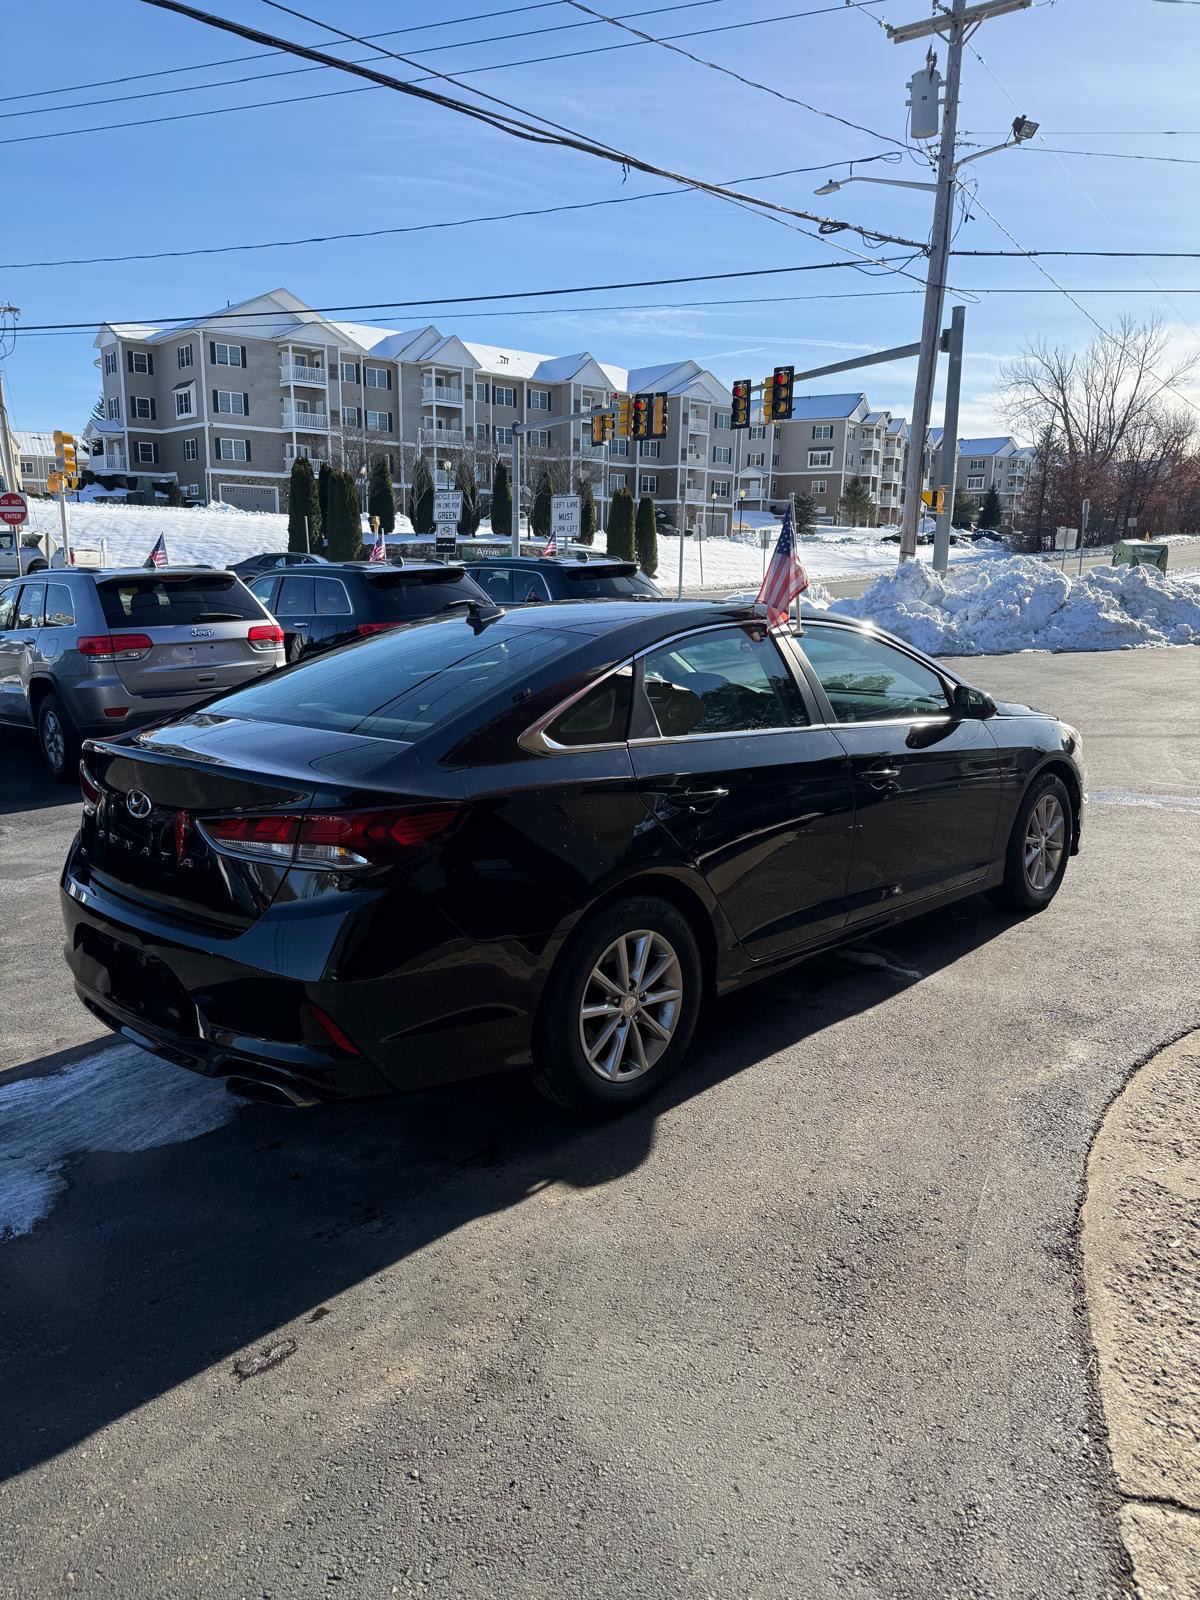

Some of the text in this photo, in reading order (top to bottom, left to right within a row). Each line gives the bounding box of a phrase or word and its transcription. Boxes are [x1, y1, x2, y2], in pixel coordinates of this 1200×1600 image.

[554, 501, 578, 509] LEFT LANE
[437, 511, 457, 519] GREEN
[558, 512, 574, 521] MUST
[190, 627, 214, 637] Jeep
